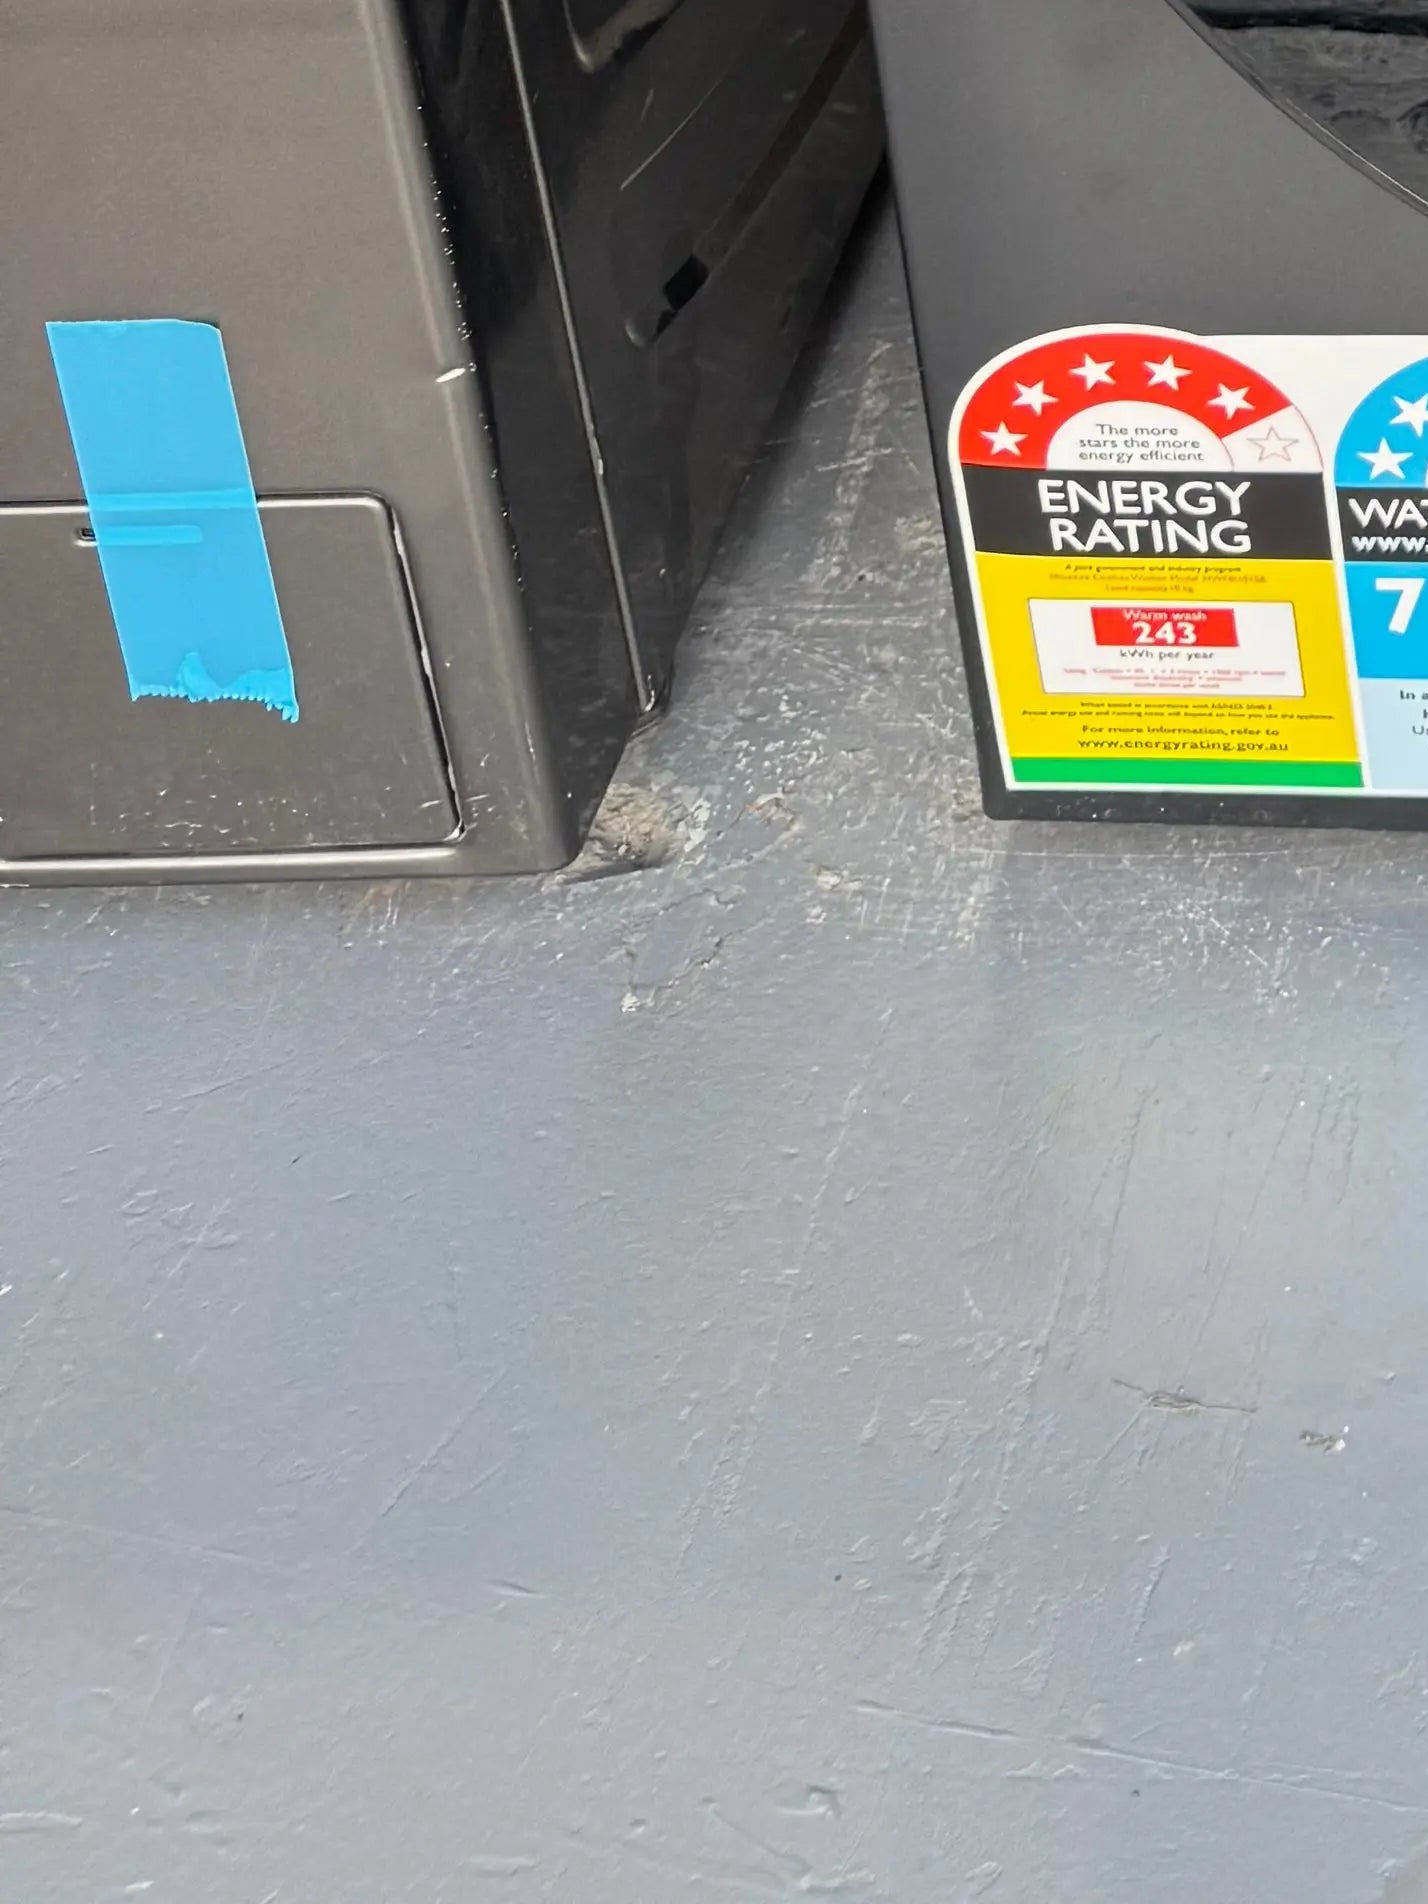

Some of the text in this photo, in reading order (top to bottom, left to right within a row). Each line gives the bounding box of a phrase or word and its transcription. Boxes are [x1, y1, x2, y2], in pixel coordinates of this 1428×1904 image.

[1096, 423, 1179, 436] The more
[1079, 437, 1200, 449] stars the more
[1078, 449, 1205, 464] energy efficient
[1037, 478, 1252, 517] ENERGY
[1048, 516, 1252, 554] RATING
[1122, 608, 1208, 622] Warm wash
[1130, 621, 1198, 646] 243
[1119, 649, 1216, 662] kWh per year
[1399, 691, 1416, 701] In
[1082, 725, 1280, 737] For more information, refer to
[1077, 738, 1289, 753] www.energyrating.gov.au
